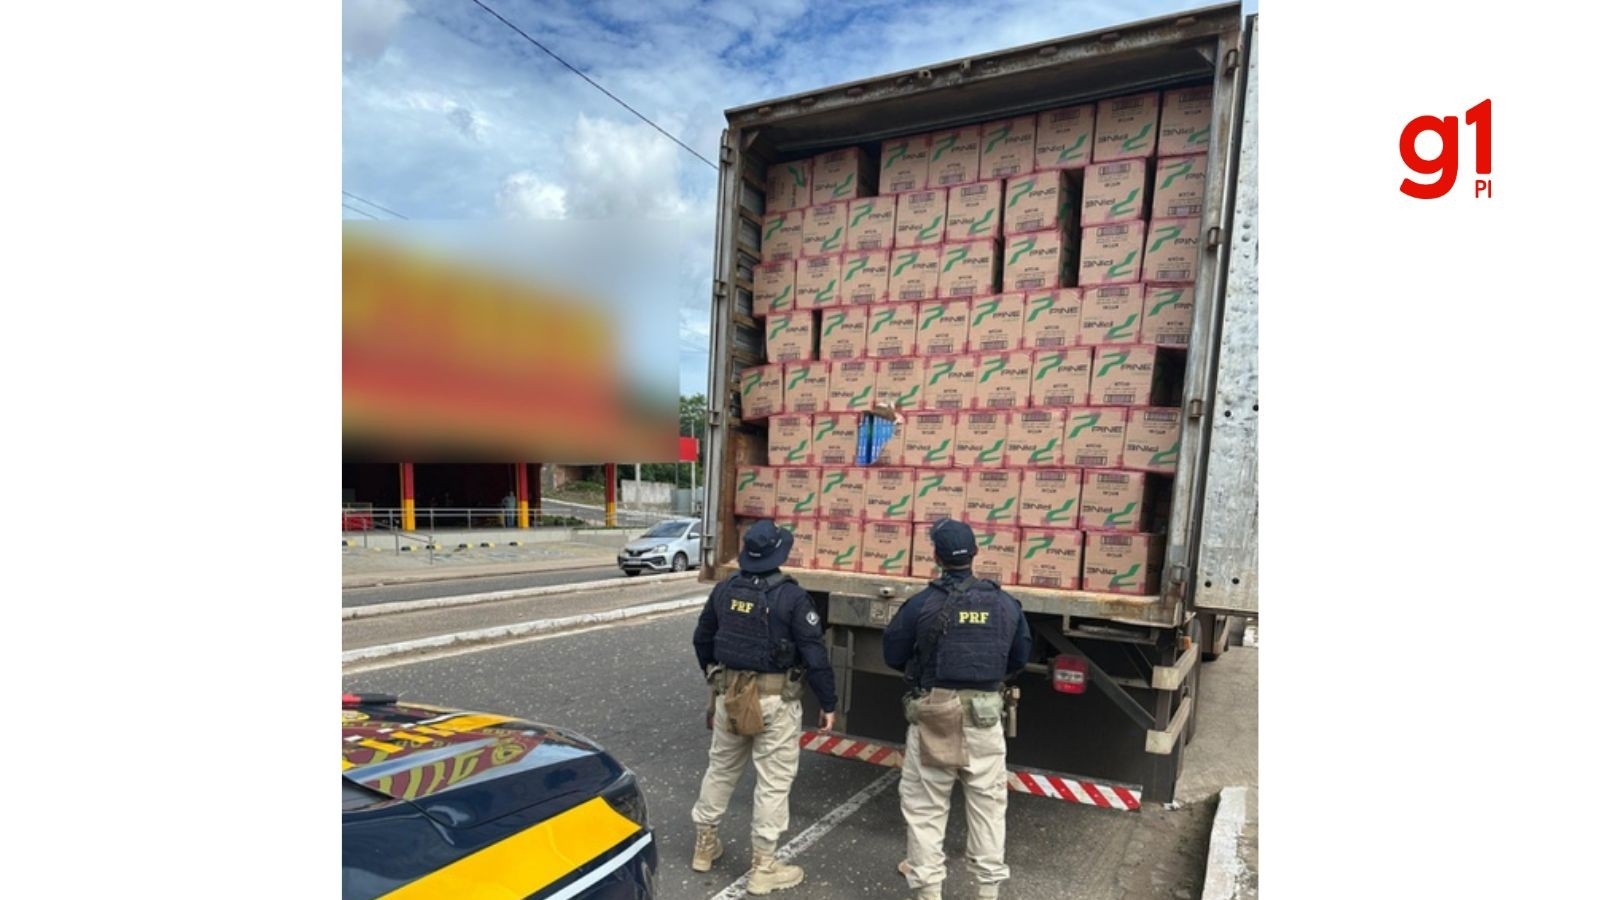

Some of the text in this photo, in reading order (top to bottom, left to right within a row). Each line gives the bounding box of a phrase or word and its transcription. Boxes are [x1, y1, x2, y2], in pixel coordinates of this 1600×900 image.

[1163, 127, 1195, 136] PINE
[1005, 134, 1032, 143] PINE
[1098, 134, 1128, 143] PINE
[951, 144, 977, 153] PINE
[1038, 145, 1065, 153] PINE
[903, 152, 926, 160] PINE
[1185, 172, 1205, 180] PIN
[1029, 188, 1056, 197] PINE
[1085, 198, 1115, 208] PINE
[949, 217, 975, 226] PINE
[898, 224, 923, 232] PINE
[1029, 248, 1058, 256] PINE
[1083, 260, 1113, 268] PINE
[993, 310, 1020, 318] PINE
[1001, 368, 1028, 376] PINE
[1058, 364, 1087, 372] PINE
[948, 371, 974, 379] PINE
[1127, 444, 1159, 452] PINE
[968, 502, 994, 510] PINE
[731, 599, 754, 613] PRF
[959, 611, 989, 624] PRF
